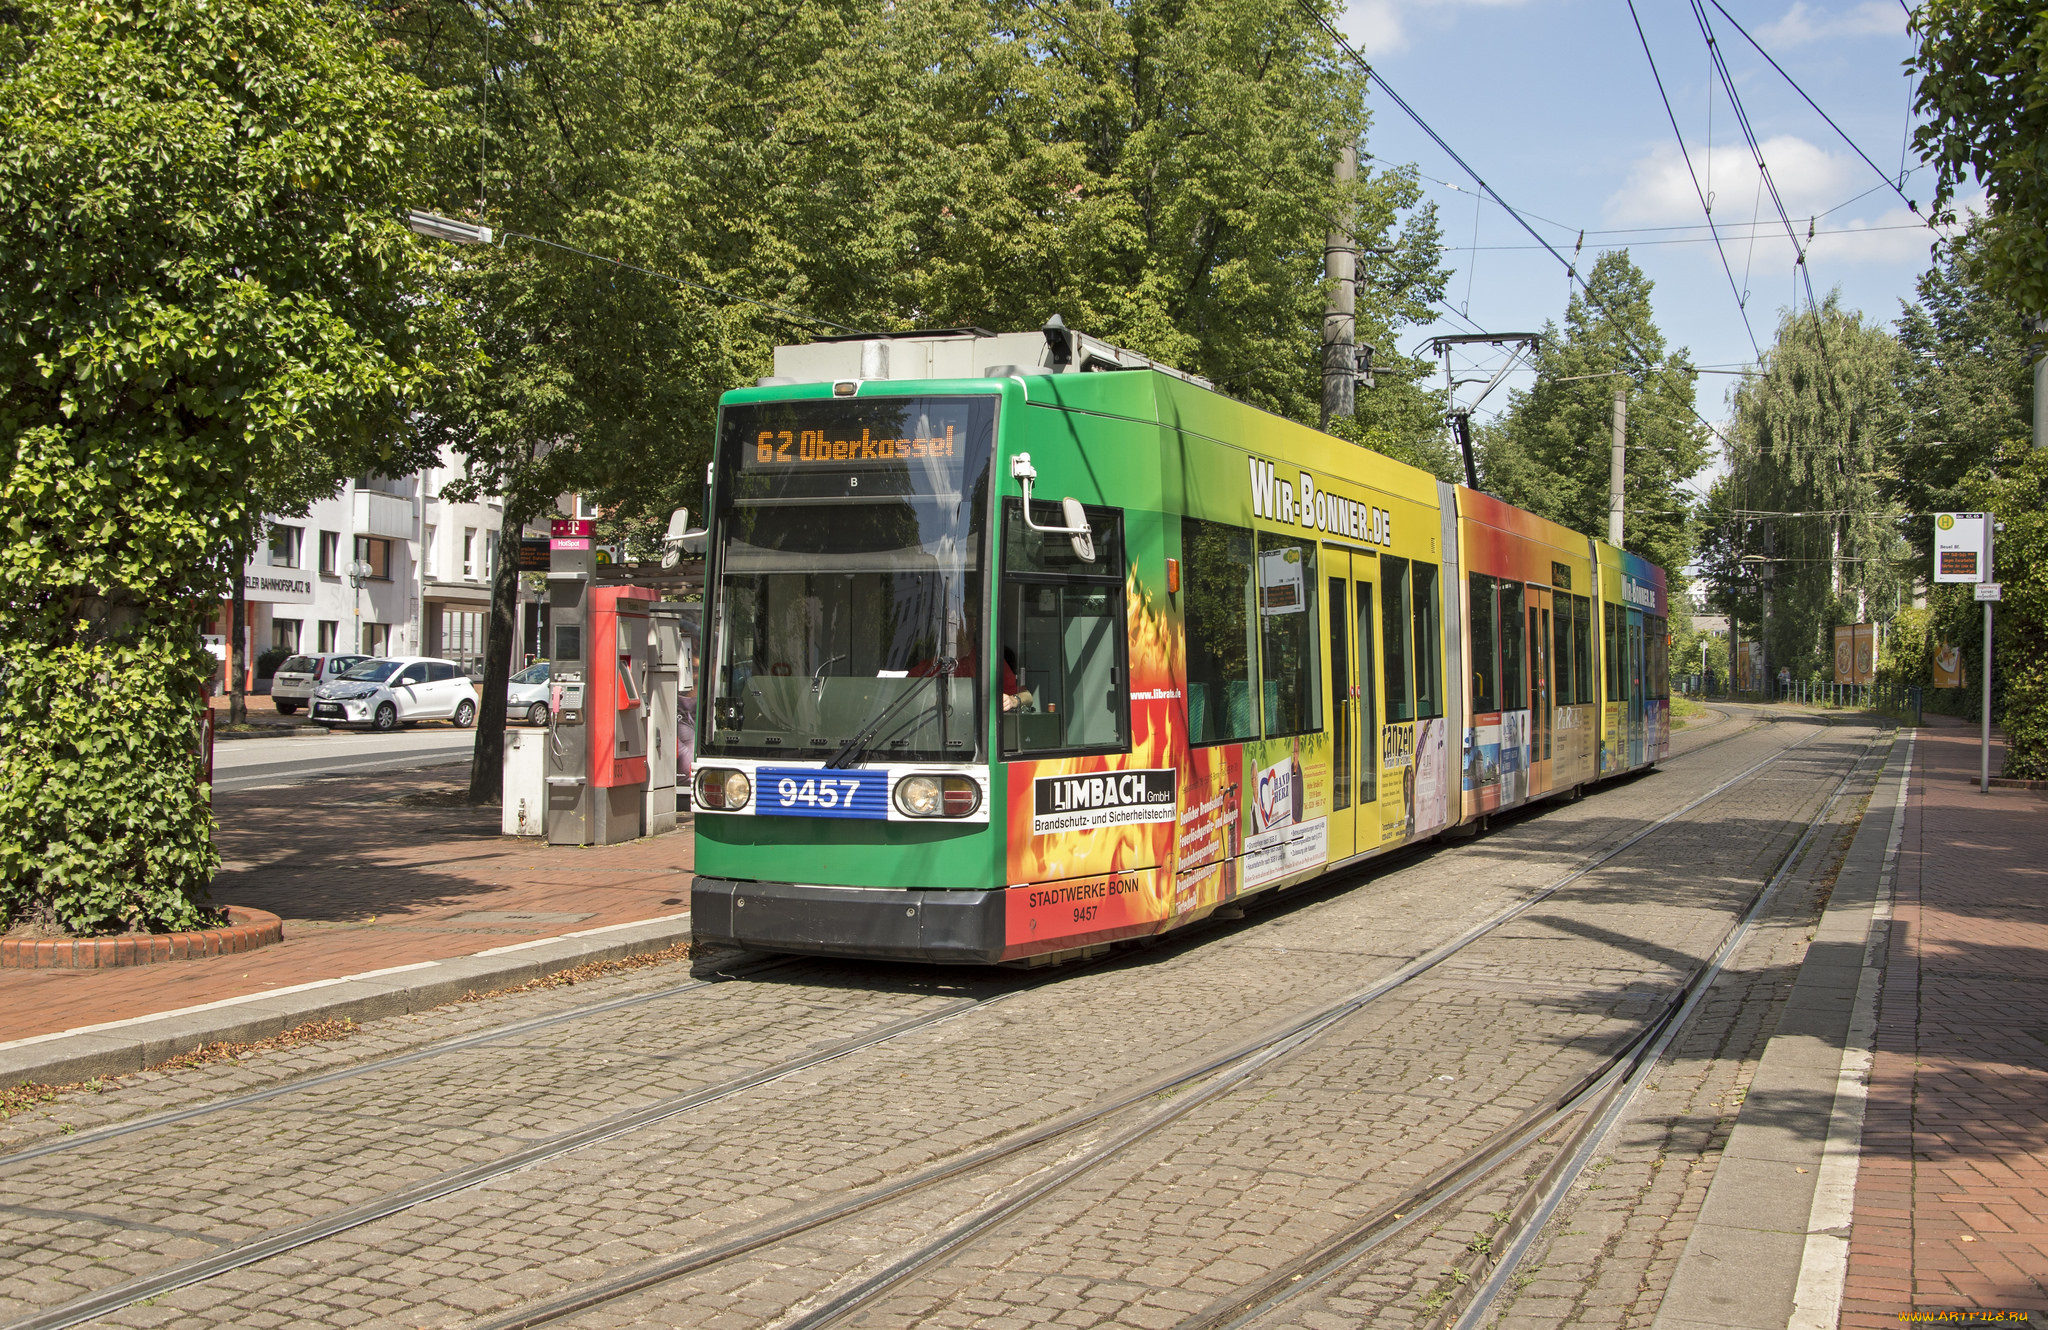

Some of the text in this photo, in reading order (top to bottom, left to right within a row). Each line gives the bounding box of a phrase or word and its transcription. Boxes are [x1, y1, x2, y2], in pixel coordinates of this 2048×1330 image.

[757, 425, 954, 463] 62 Oberkassel
[850, 477, 858, 487] B
[567, 520, 580, 535] T
[558, 540, 580, 548] HotSpot
[245, 576, 311, 594] ELER BAHNHOFSPLATZ 18
[729, 707, 735, 718] 3
[1382, 724, 1414, 762] tanzen
[1273, 772, 1290, 791] HAND
[778, 778, 860, 808] 9457
[1054, 774, 1170, 811] LIMBACH GmbH
[1273, 785, 1289, 804] HERZ
[1035, 805, 1175, 832] Brandschutz- und Sicherheitstechnik
[1029, 878, 1139, 908] STADTWERKE BONN
[1073, 905, 1098, 922] 9457
